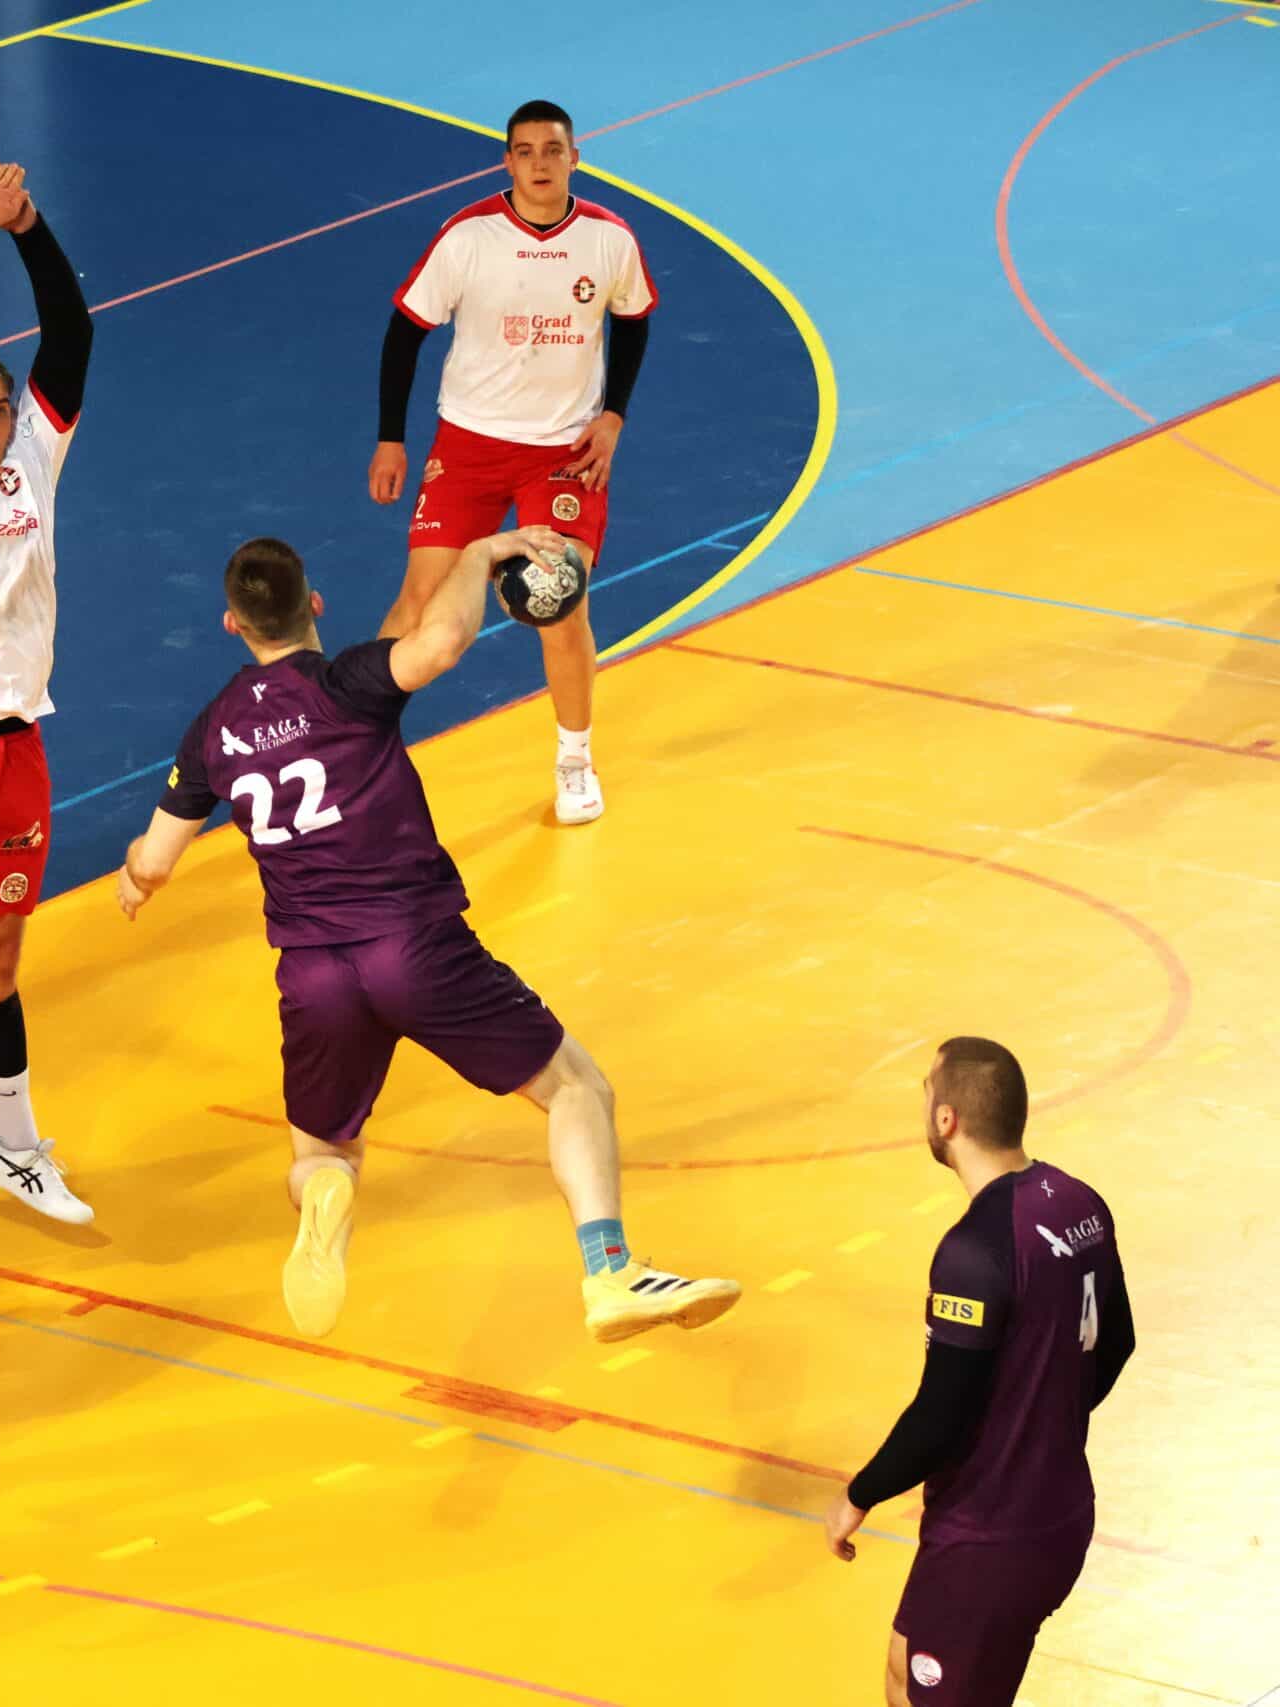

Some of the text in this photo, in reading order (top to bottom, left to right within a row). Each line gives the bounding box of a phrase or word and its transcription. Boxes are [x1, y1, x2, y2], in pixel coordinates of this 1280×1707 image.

[516, 250, 568, 260] GIVOVA
[531, 314, 572, 329] Grad
[531, 330, 585, 345] Zenica
[253, 714, 311, 743] EAGLE
[231, 758, 343, 845] 22
[1064, 1215, 1104, 1245] EAGLE
[940, 1299, 974, 1320] FIS
